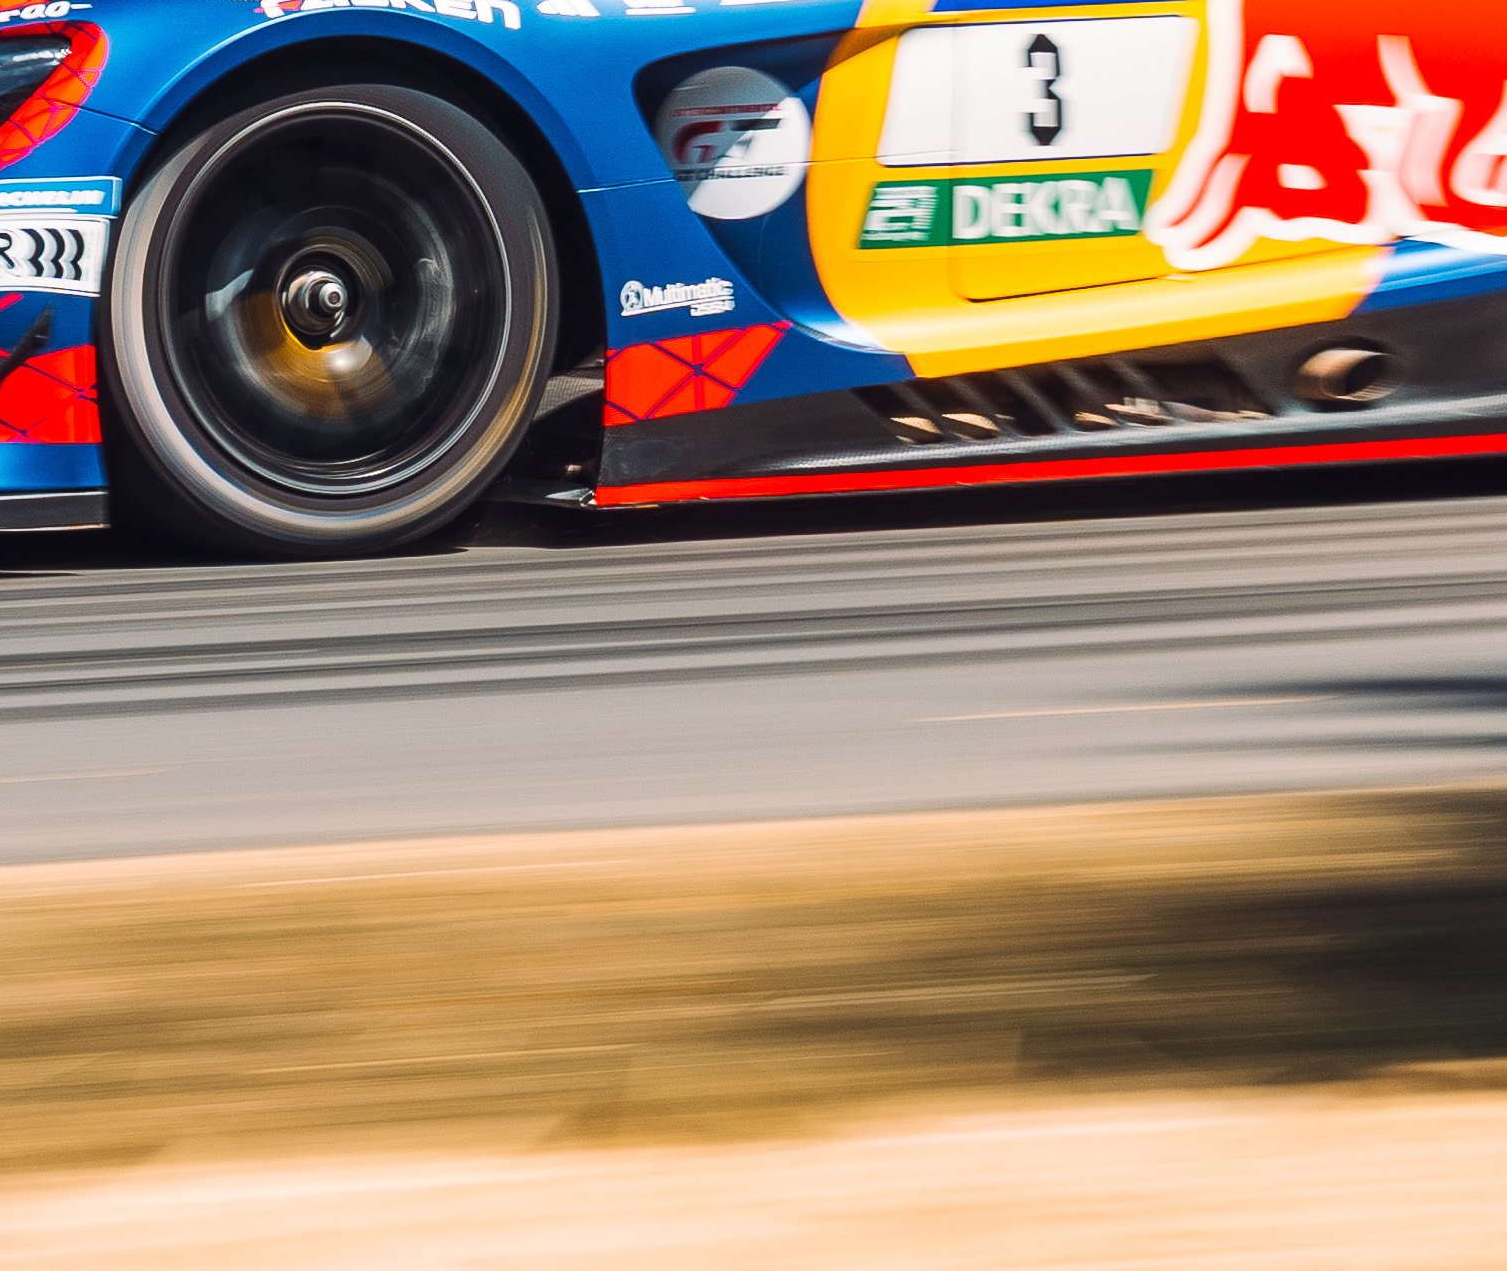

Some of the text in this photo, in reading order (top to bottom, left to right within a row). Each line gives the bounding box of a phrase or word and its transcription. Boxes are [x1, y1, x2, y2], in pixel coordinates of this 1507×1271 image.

[1024, 33, 1063, 146] 3
[951, 176, 1142, 240] DEKRA
[642, 276, 734, 308] Multimatic
